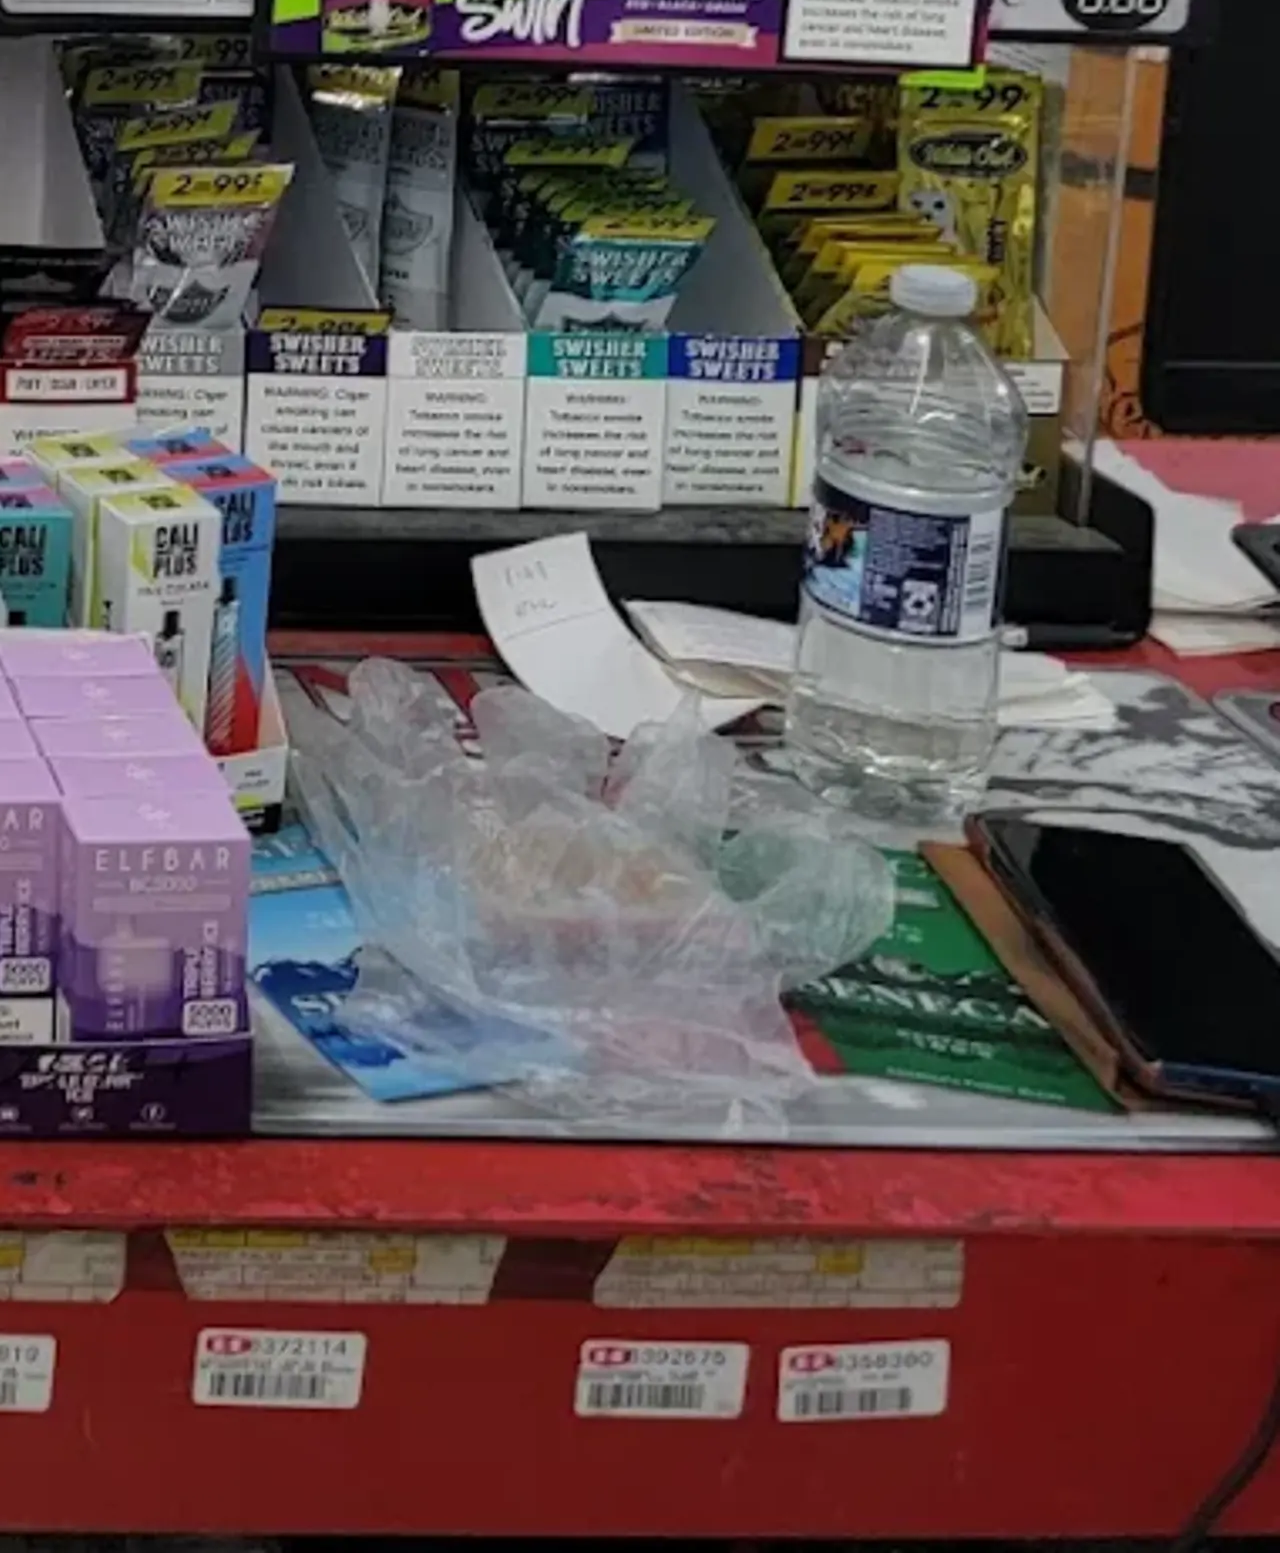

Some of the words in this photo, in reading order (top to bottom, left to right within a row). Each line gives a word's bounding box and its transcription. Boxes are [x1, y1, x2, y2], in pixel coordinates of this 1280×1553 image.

[271, 333, 366, 354] SWISHER
[553, 338, 646, 358] SWISHER
[685, 340, 781, 360] SWISHER
[274, 354, 361, 374] SWEETS
[558, 358, 642, 378] SWEETS
[689, 361, 776, 380] SWEETS
[154, 524, 200, 552] CALI
[152, 553, 197, 579] PLUS
[94, 847, 231, 873] ELFBAR
[2, 961, 50, 979] 5000
